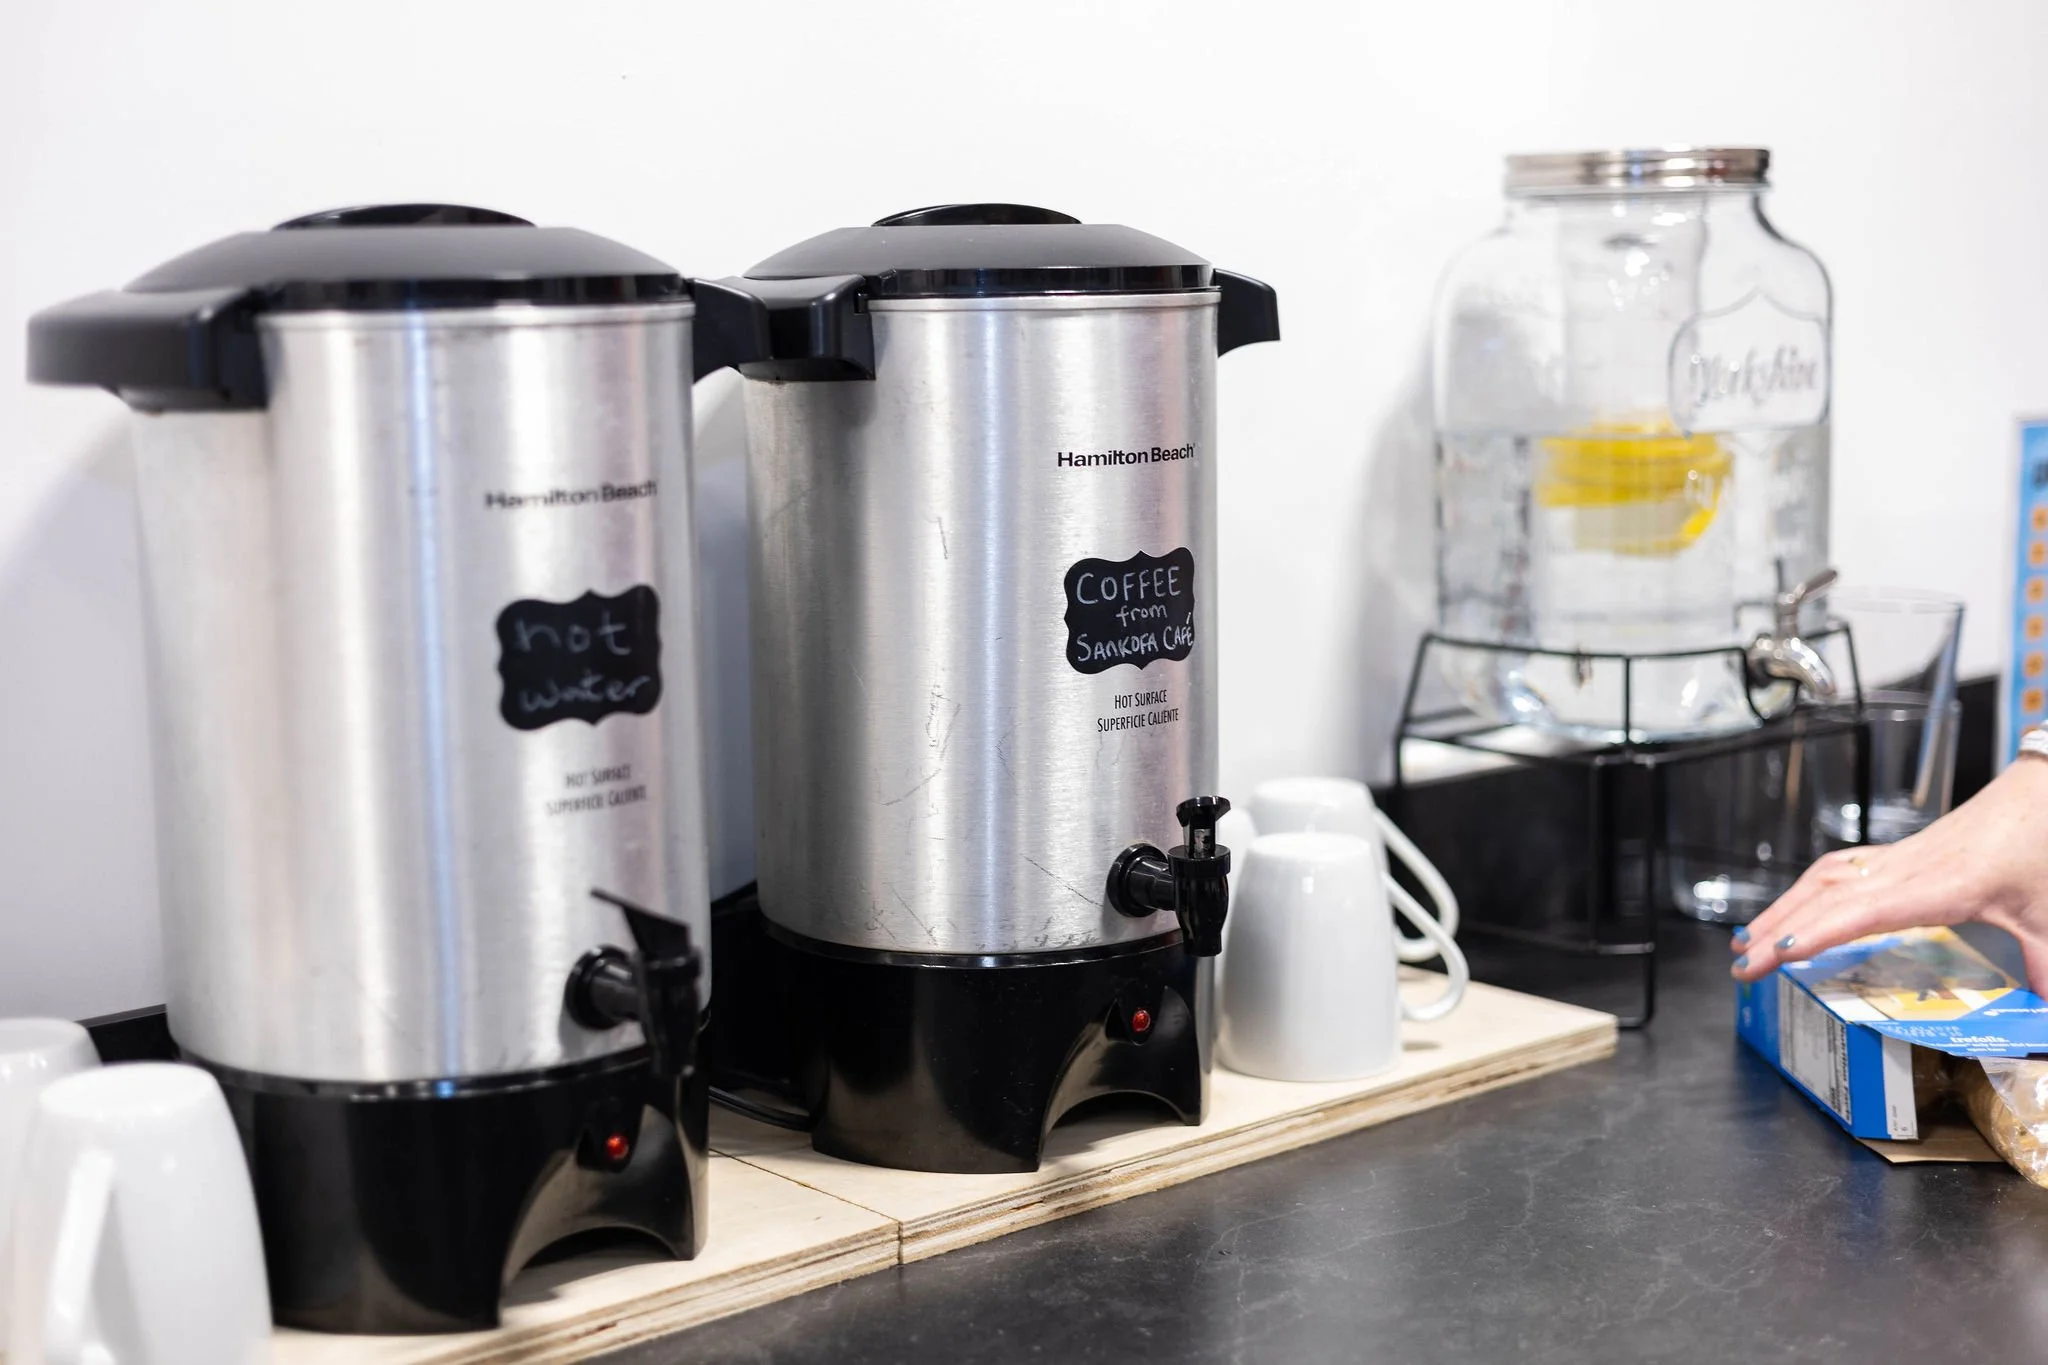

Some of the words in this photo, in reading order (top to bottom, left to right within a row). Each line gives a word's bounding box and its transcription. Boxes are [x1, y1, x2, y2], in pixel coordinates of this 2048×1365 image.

[1056, 449, 1149, 468] Hamilton
[1150, 444, 1194, 463] Beach
[485, 488, 598, 509] Hamilton
[601, 480, 658, 503] Beach
[1076, 565, 1181, 605] COFFEE
[1115, 603, 1168, 628] from
[1163, 611, 1194, 651] CAFÉ
[518, 667, 651, 713] water
[1114, 694, 1133, 710] HOT
[1135, 689, 1168, 706] SURFACE
[1097, 713, 1146, 733] SUPERFICIE
[1148, 708, 1179, 726] CALIENTE
